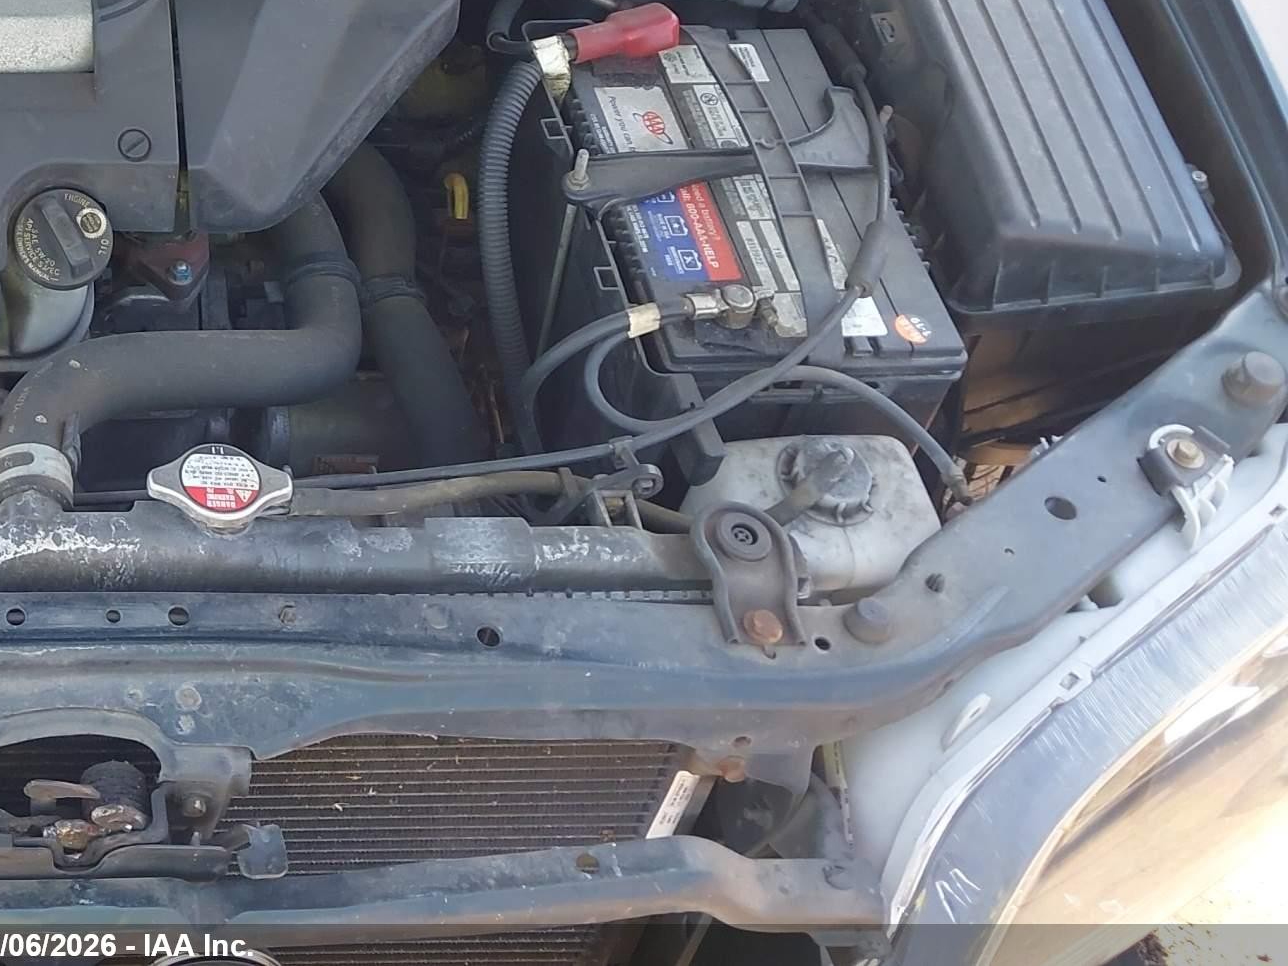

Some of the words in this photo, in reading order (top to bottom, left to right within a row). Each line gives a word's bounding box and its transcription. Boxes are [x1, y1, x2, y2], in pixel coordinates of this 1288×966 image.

[607, 95, 621, 117] Power
[615, 117, 626, 132] you
[623, 130, 634, 145] can
[643, 111, 665, 135] AAA
[680, 187, 691, 202] all:
[692, 184, 705, 202] eed
[701, 209, 721, 241] battery?
[98, 238, 110, 256] OIL
